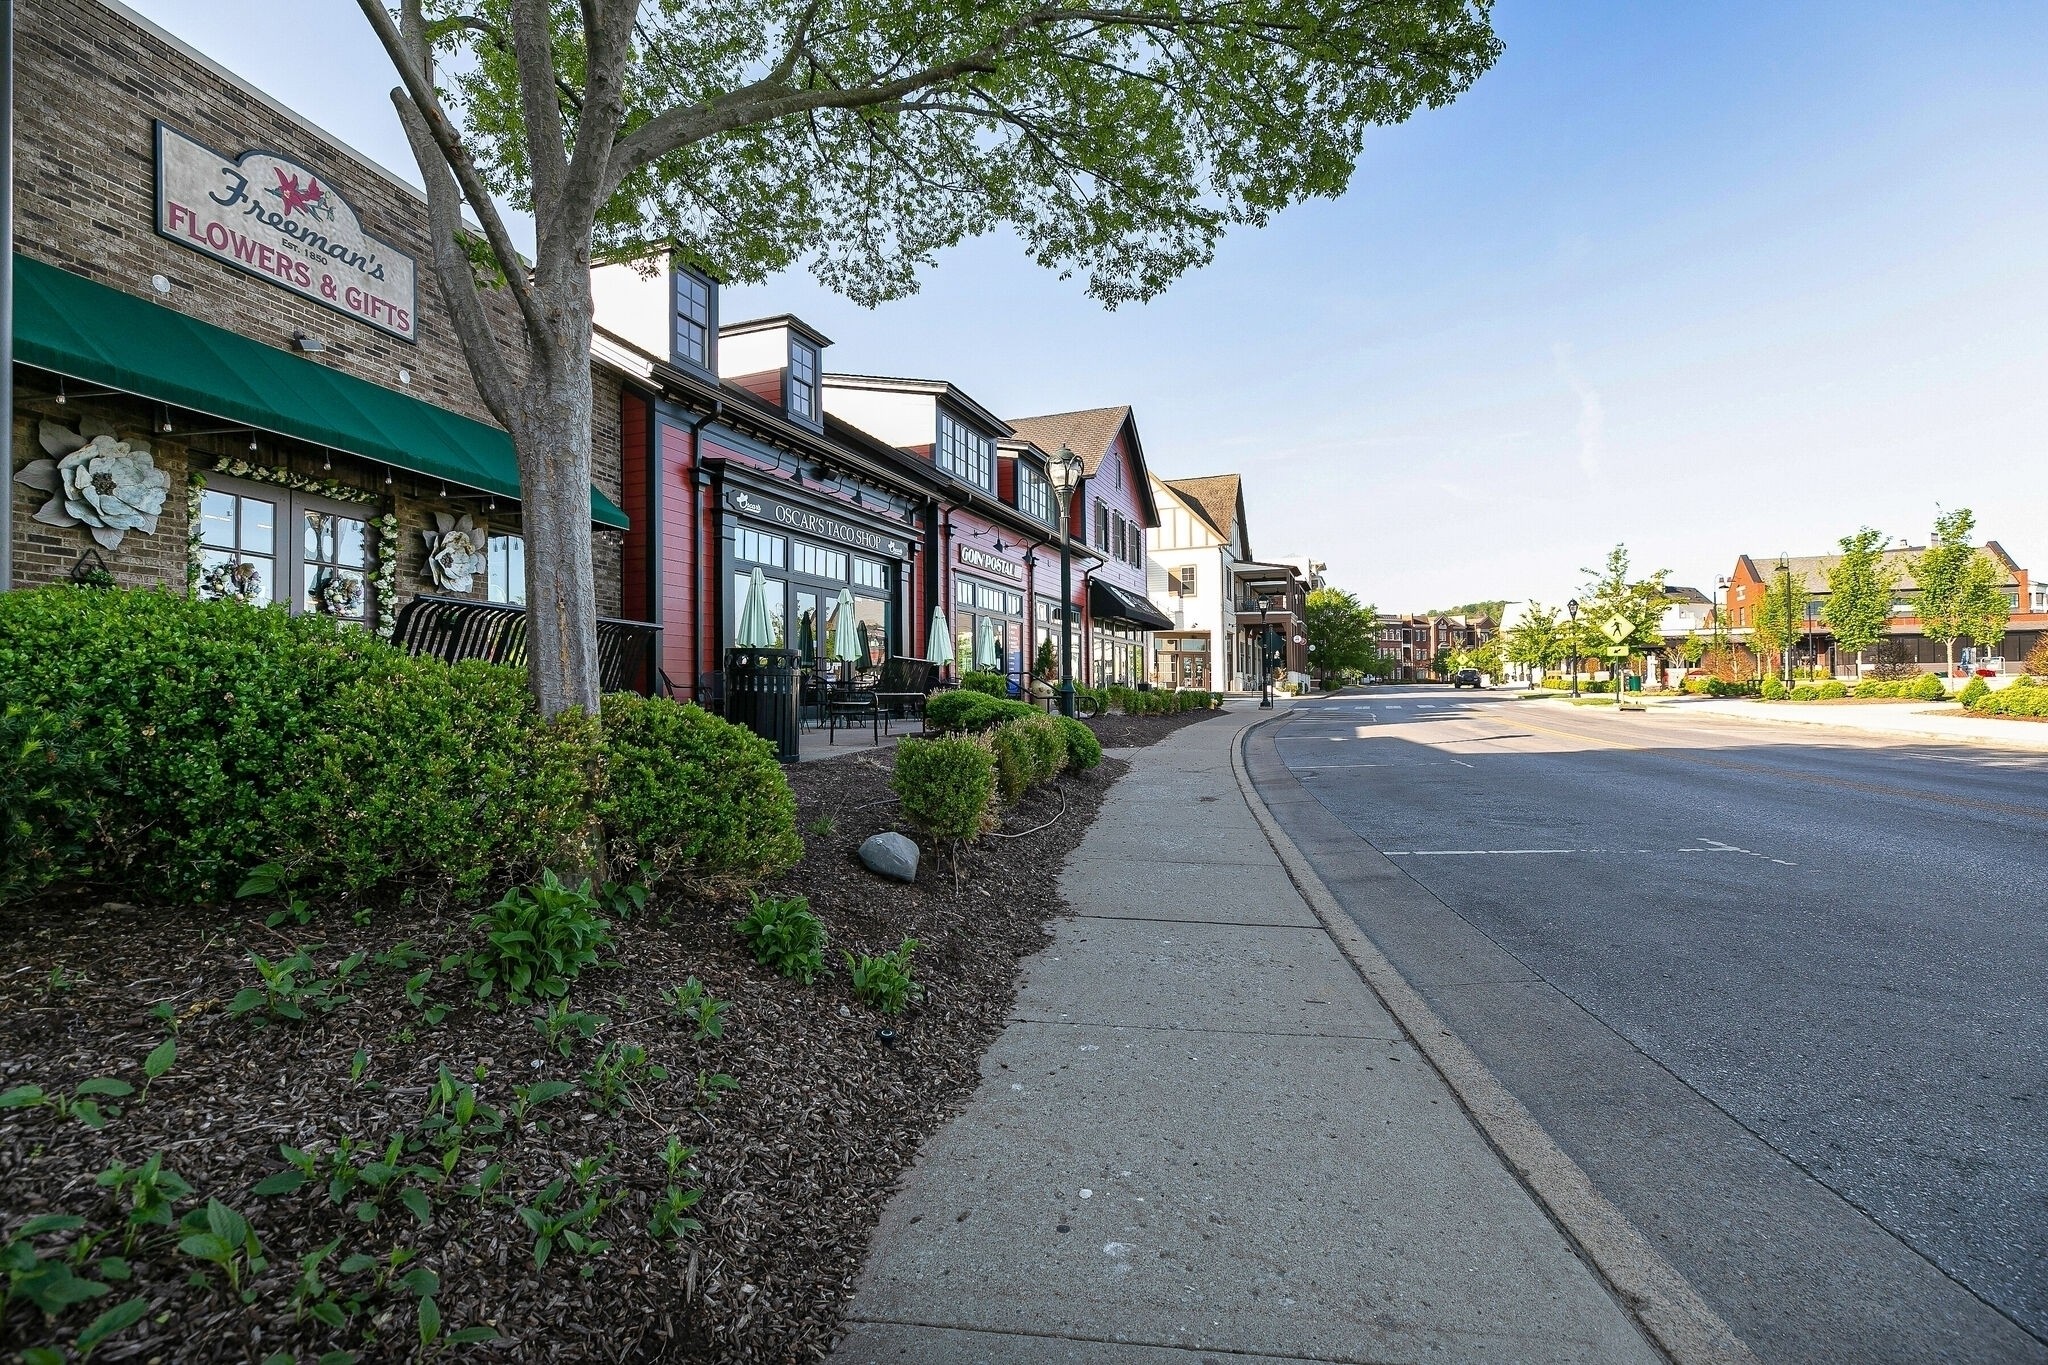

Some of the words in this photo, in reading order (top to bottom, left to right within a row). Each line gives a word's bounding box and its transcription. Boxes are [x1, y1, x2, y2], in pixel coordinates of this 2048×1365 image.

[208, 167, 385, 282] Freeman's
[167, 201, 311, 288] FLOWERS
[320, 273, 337, 302] &
[345, 286, 410, 332] GIFTS
[304, 250, 328, 266] 1850
[775, 505, 825, 533] OSCAR'S
[827, 521, 854, 542] TACO
[856, 531, 881, 549] SHOP
[985, 554, 1015, 577] POSTAL
